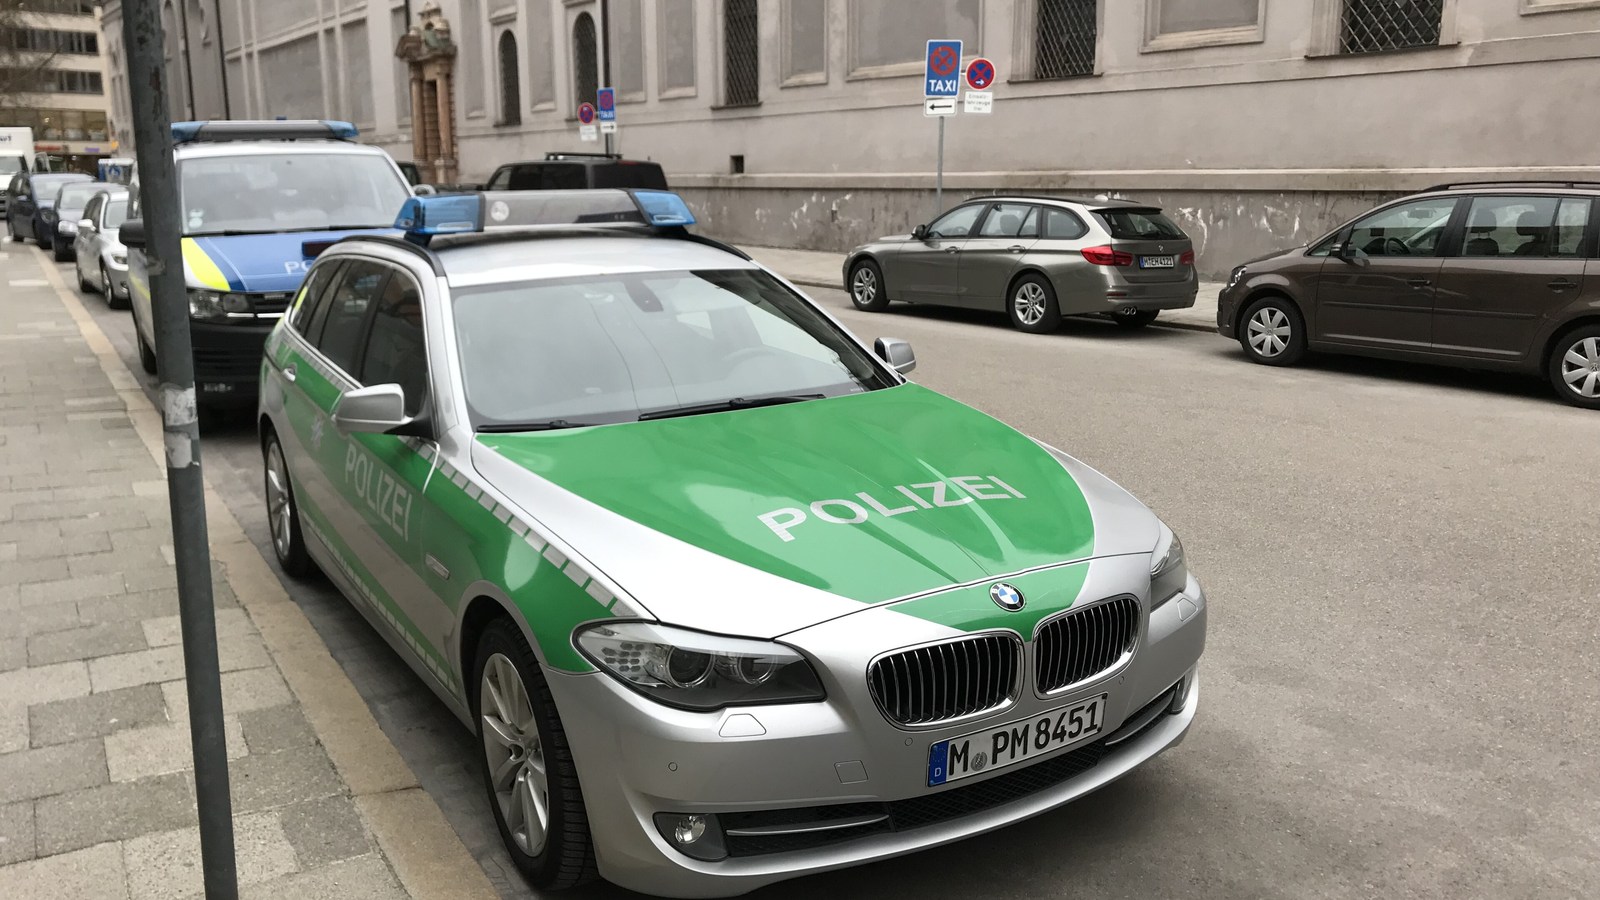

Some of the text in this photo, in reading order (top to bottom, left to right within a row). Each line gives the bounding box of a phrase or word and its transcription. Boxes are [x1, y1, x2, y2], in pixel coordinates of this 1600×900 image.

[929, 80, 956, 92] TAXI
[344, 443, 413, 543] POLIZEI
[757, 475, 1027, 542] POLIZEI
[934, 767, 942, 777] D
[949, 701, 1098, 776] M PM 8451
